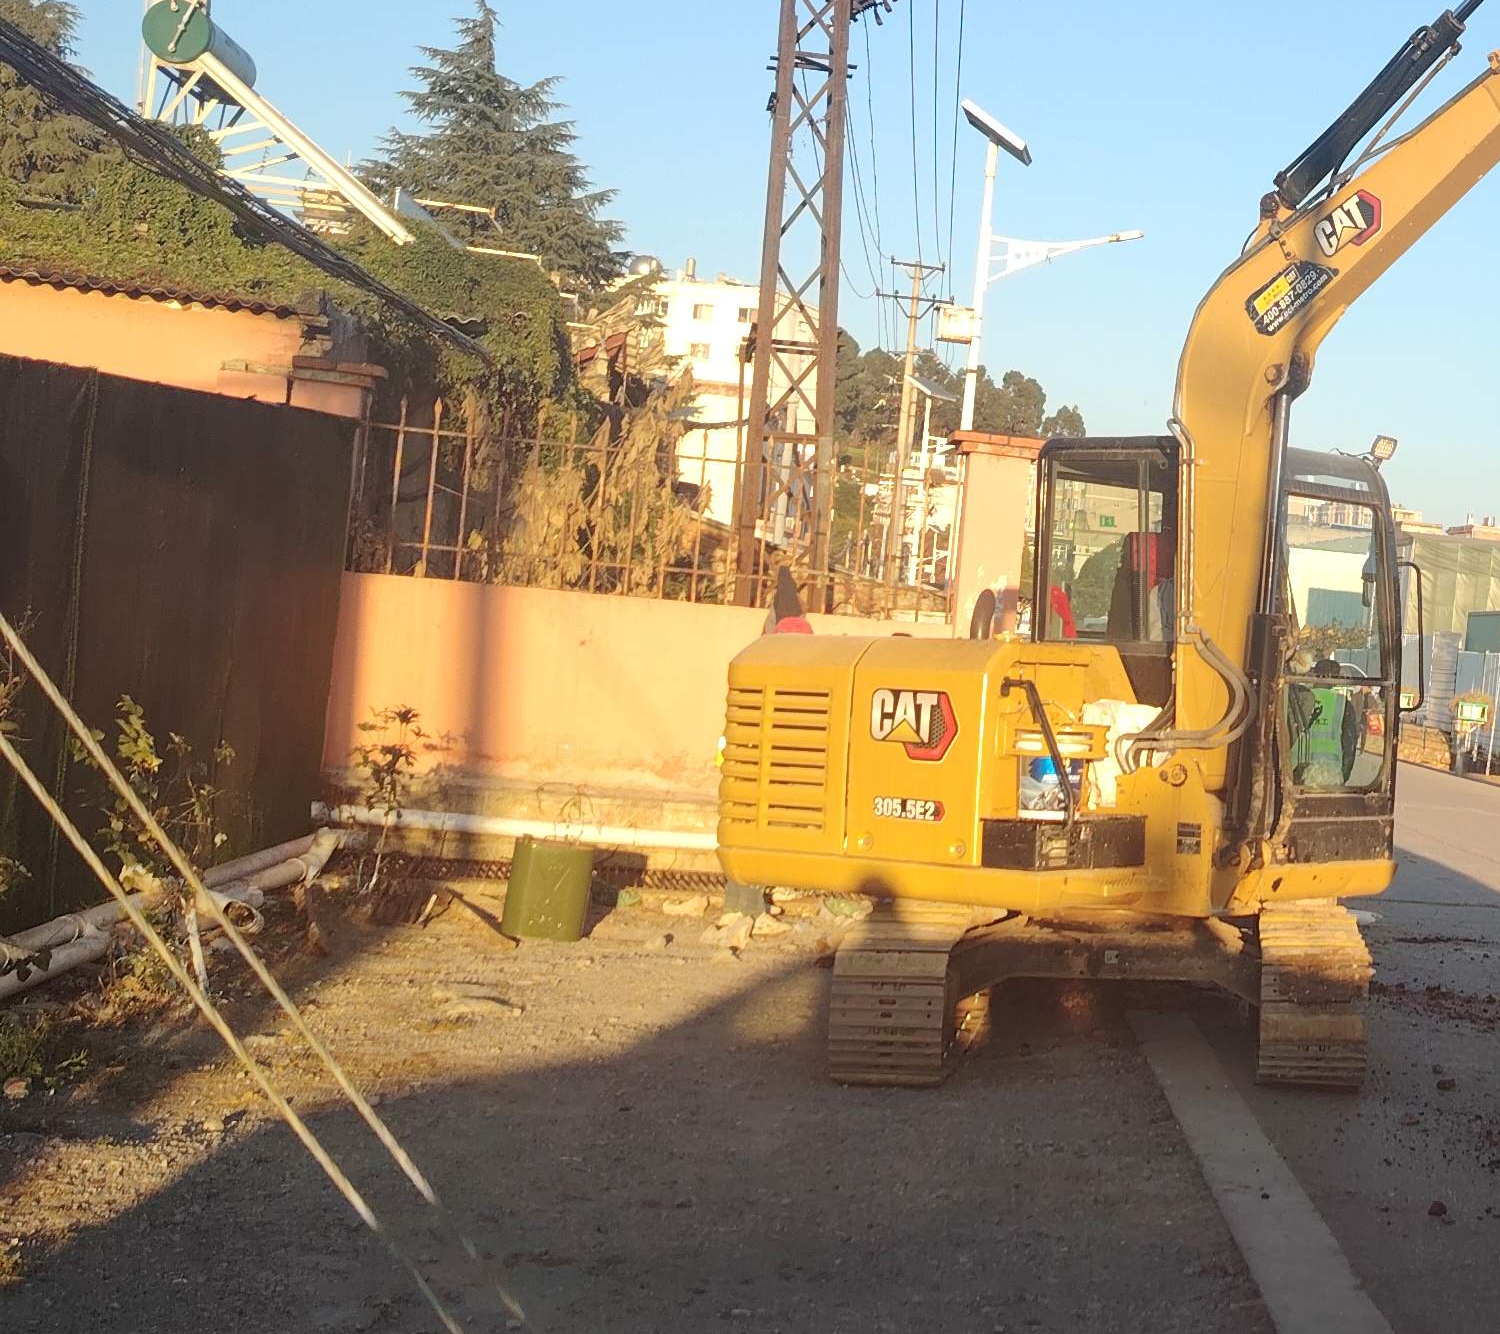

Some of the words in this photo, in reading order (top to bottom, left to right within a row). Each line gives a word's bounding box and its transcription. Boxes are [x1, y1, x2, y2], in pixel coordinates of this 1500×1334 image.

[1313, 194, 1368, 258] CAT
[870, 687, 939, 744] CAT
[873, 795, 936, 821] 305.5E2
